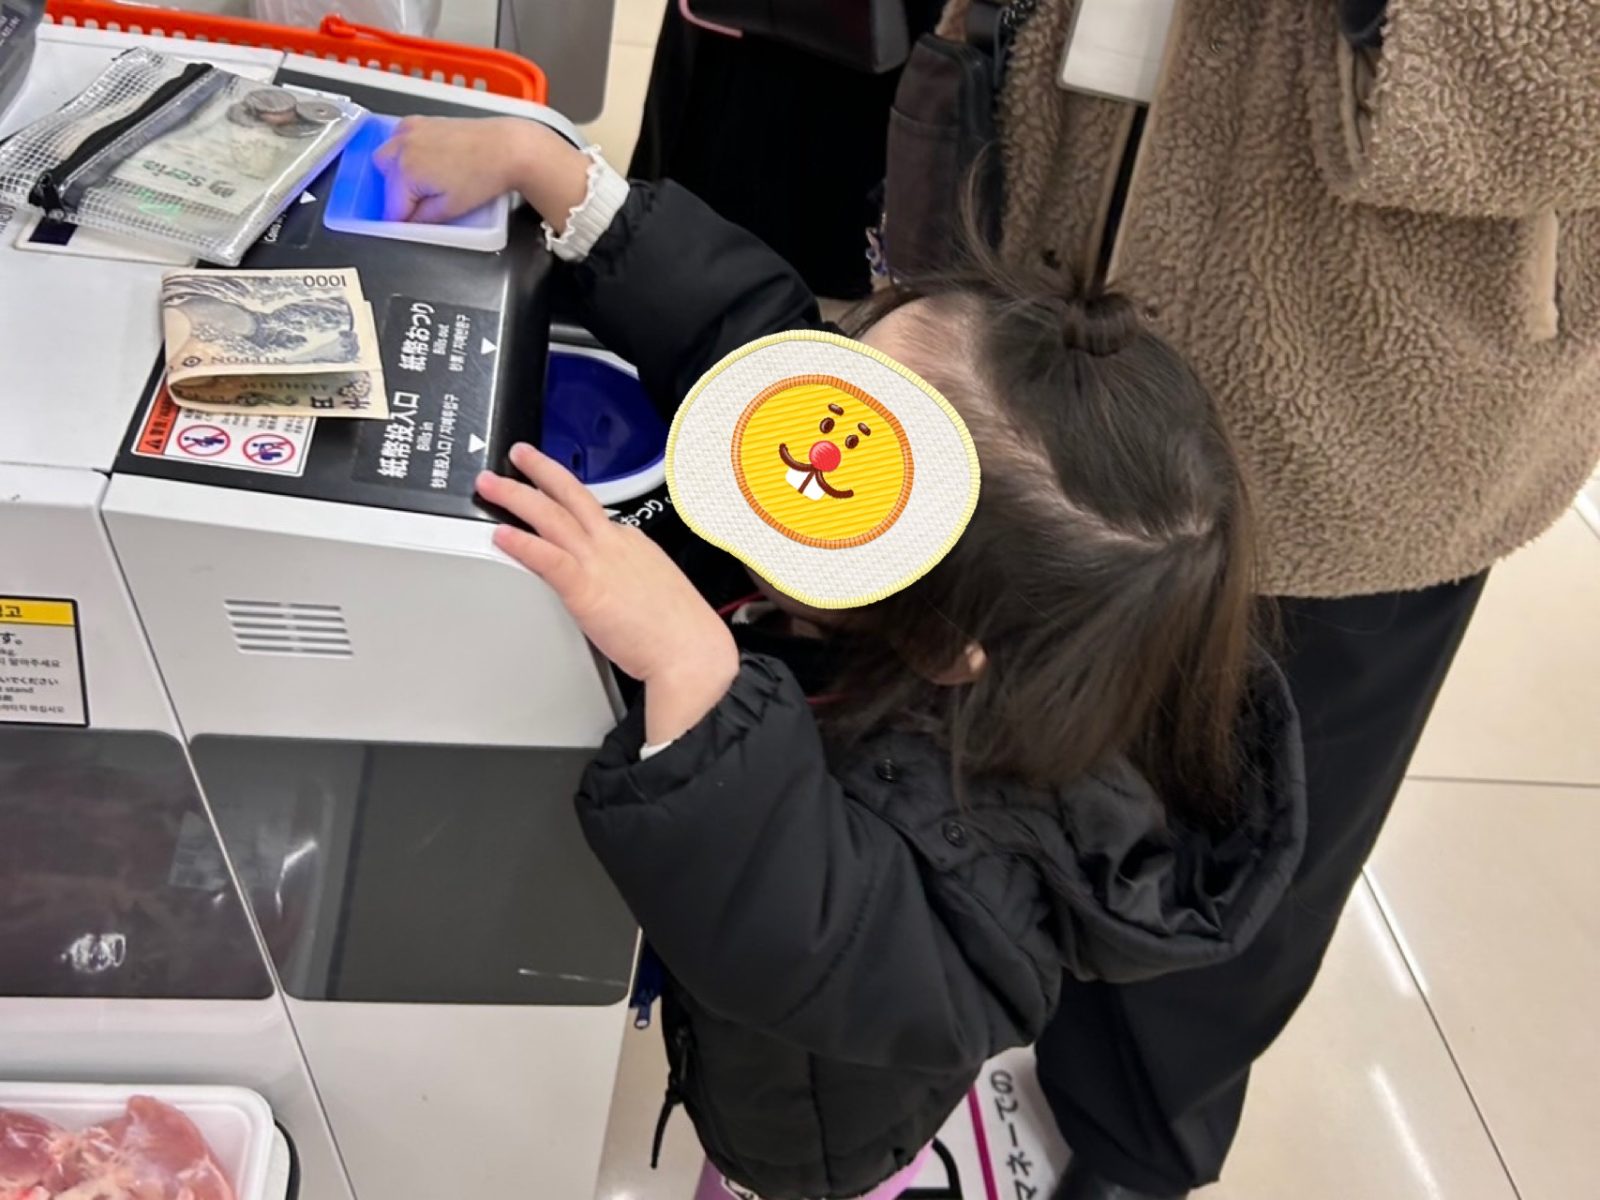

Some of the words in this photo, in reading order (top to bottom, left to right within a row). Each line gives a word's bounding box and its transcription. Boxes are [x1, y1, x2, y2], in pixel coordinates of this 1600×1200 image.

[303, 275, 347, 287] 1000
[398, 302, 435, 372] 紙幣おつり
[433, 338, 448, 355] Bills
[210, 355, 287, 365] NIPPON
[377, 391, 420, 478] 紙幣投入口
[416, 432, 433, 451] Bills
